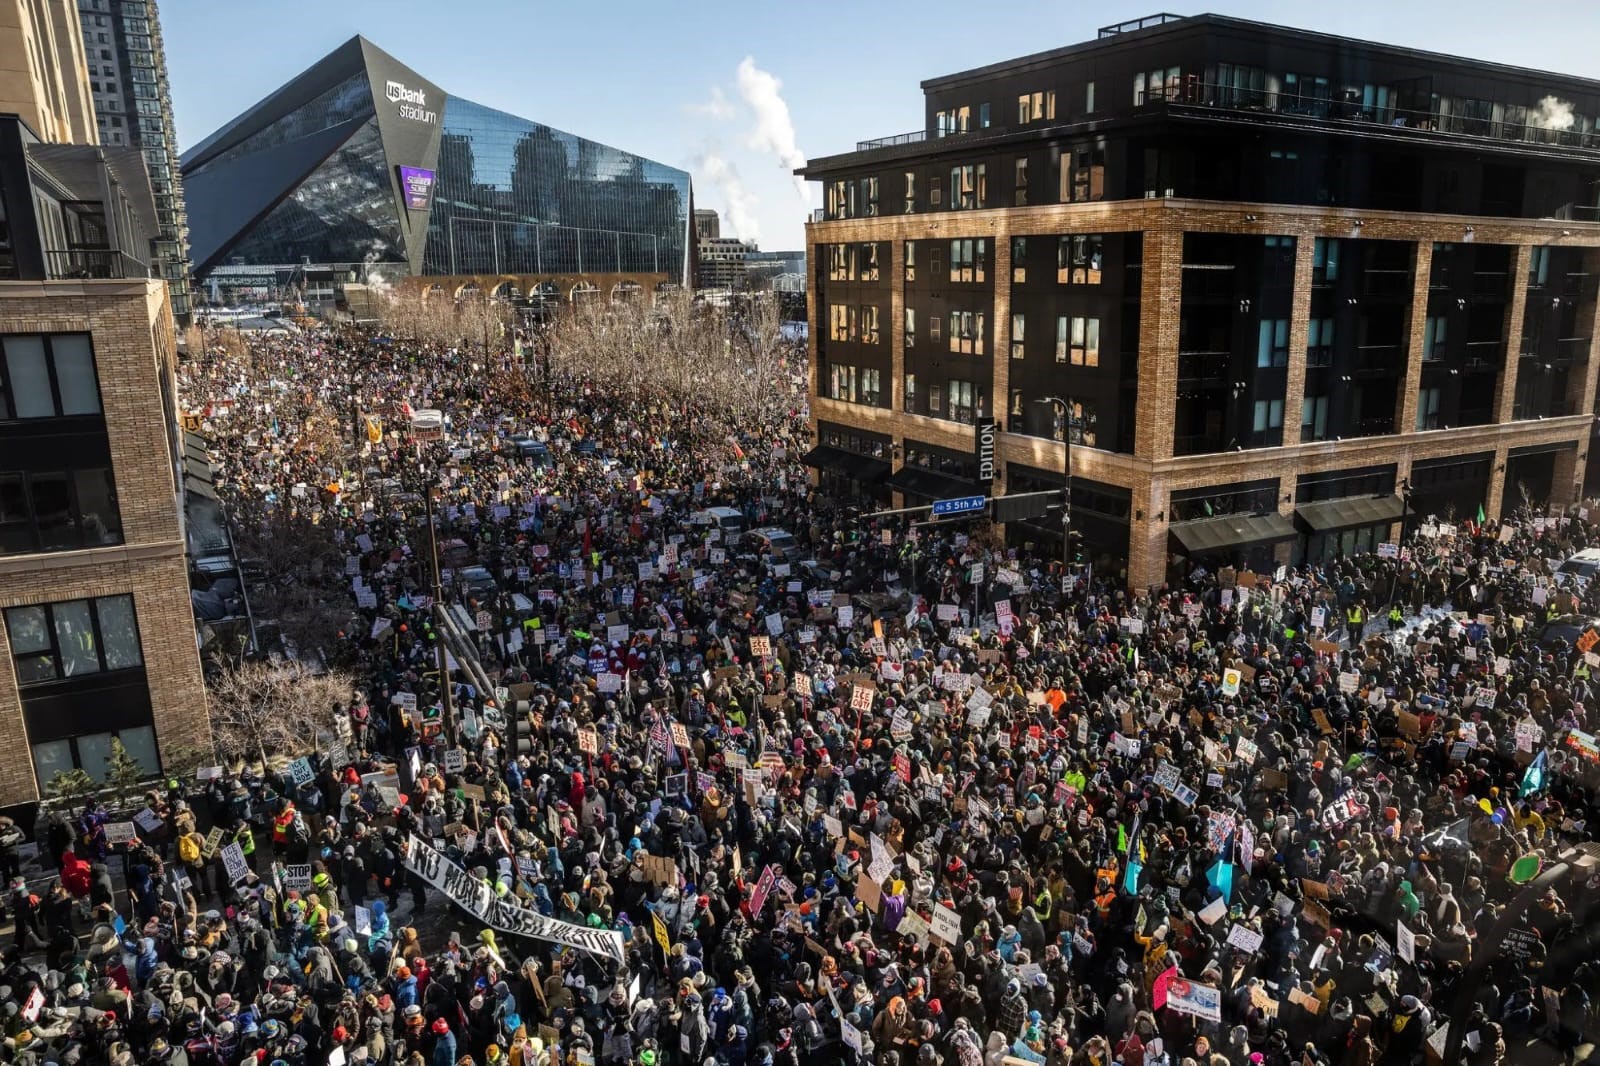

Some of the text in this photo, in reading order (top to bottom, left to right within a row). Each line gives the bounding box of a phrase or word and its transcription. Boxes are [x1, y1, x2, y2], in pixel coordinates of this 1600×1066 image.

[399, 104, 436, 124] stadium
[980, 425, 994, 480] EDITION
[945, 502, 952, 511] S
[954, 500, 970, 509] 5th
[972, 498, 983, 508] Av
[855, 690, 870, 701] ICE
[853, 699, 870, 709] OUT!
[291, 760, 302, 769] ICE
[294, 767, 306, 777] OUT
[296, 771, 311, 784] NOW
[224, 844, 237, 854] ICE
[226, 851, 239, 862] OUT
[228, 860, 243, 872] FOR
[287, 866, 310, 878] STOP
[230, 866, 248, 881] GOOD
[411, 841, 441, 881] NO
[443, 863, 484, 915] MORE
[934, 911, 959, 929] ABOLISH
